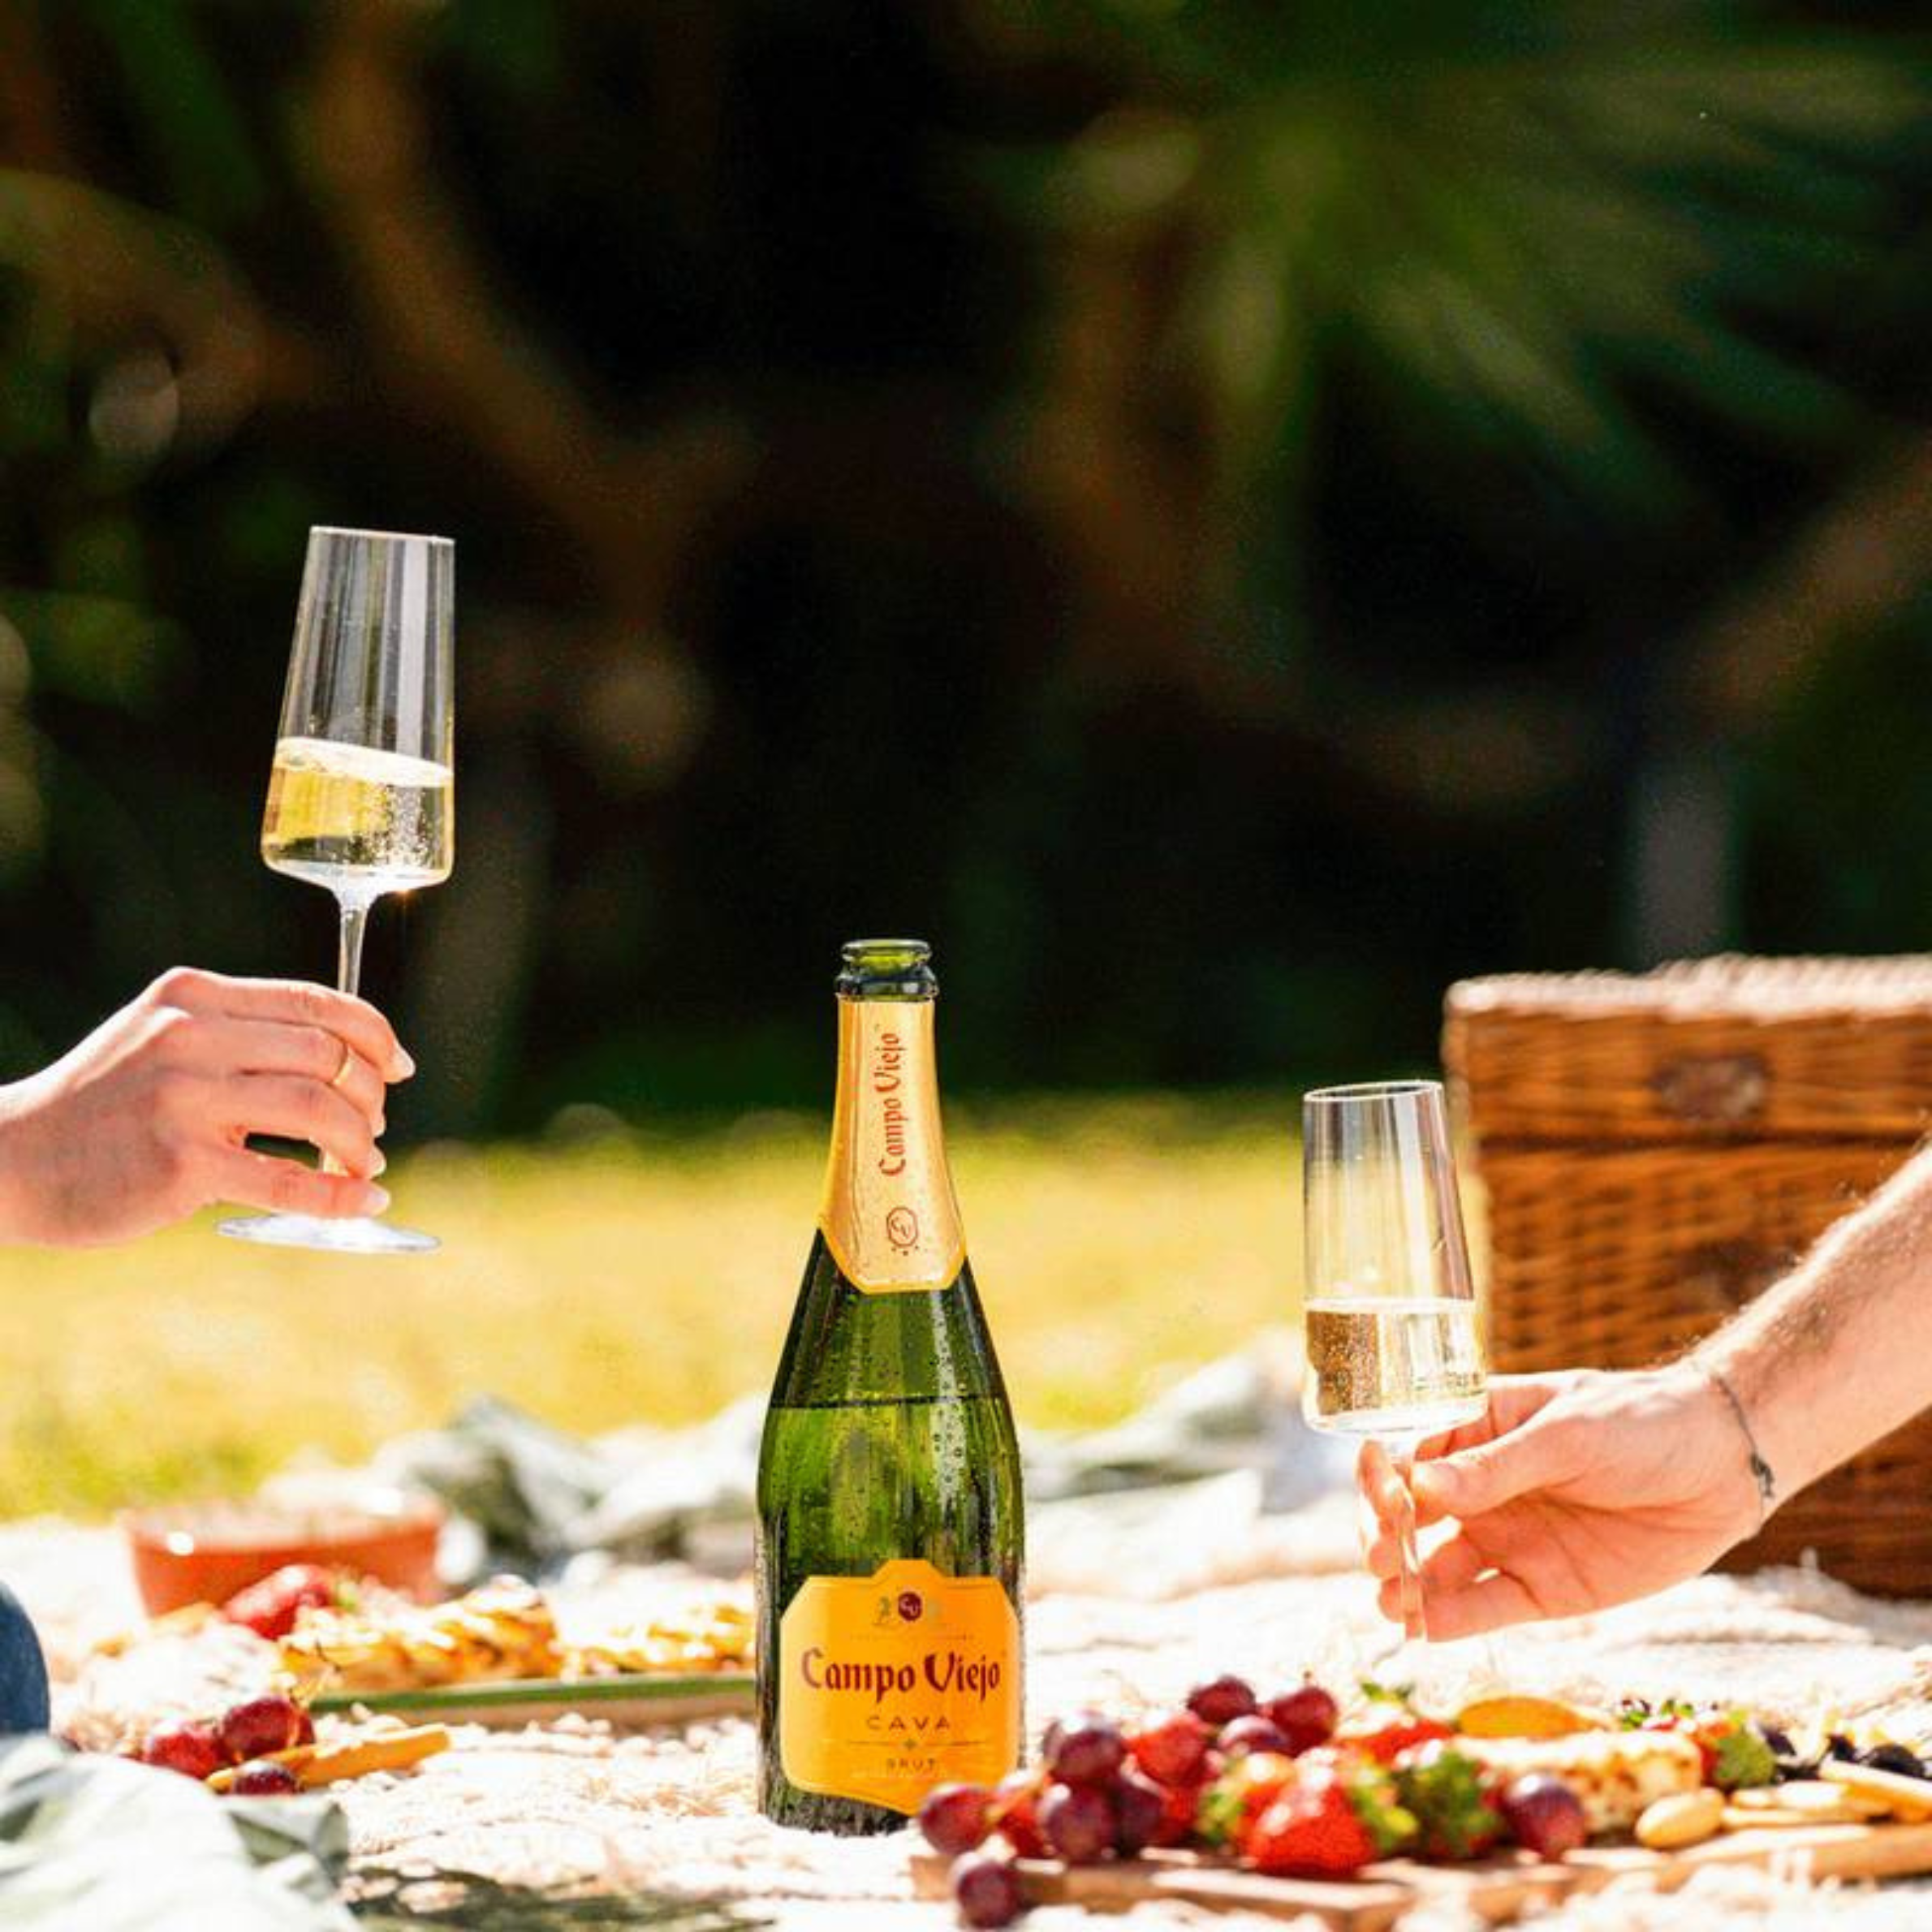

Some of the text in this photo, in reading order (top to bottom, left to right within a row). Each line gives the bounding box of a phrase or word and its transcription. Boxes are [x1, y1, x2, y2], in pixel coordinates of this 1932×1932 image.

[874, 1033, 908, 1177] Campo Viejo
[801, 1647, 1000, 1704] Campo Viejo
[866, 1715, 950, 1731] CAVA
[887, 1757, 935, 1770] BRUT
